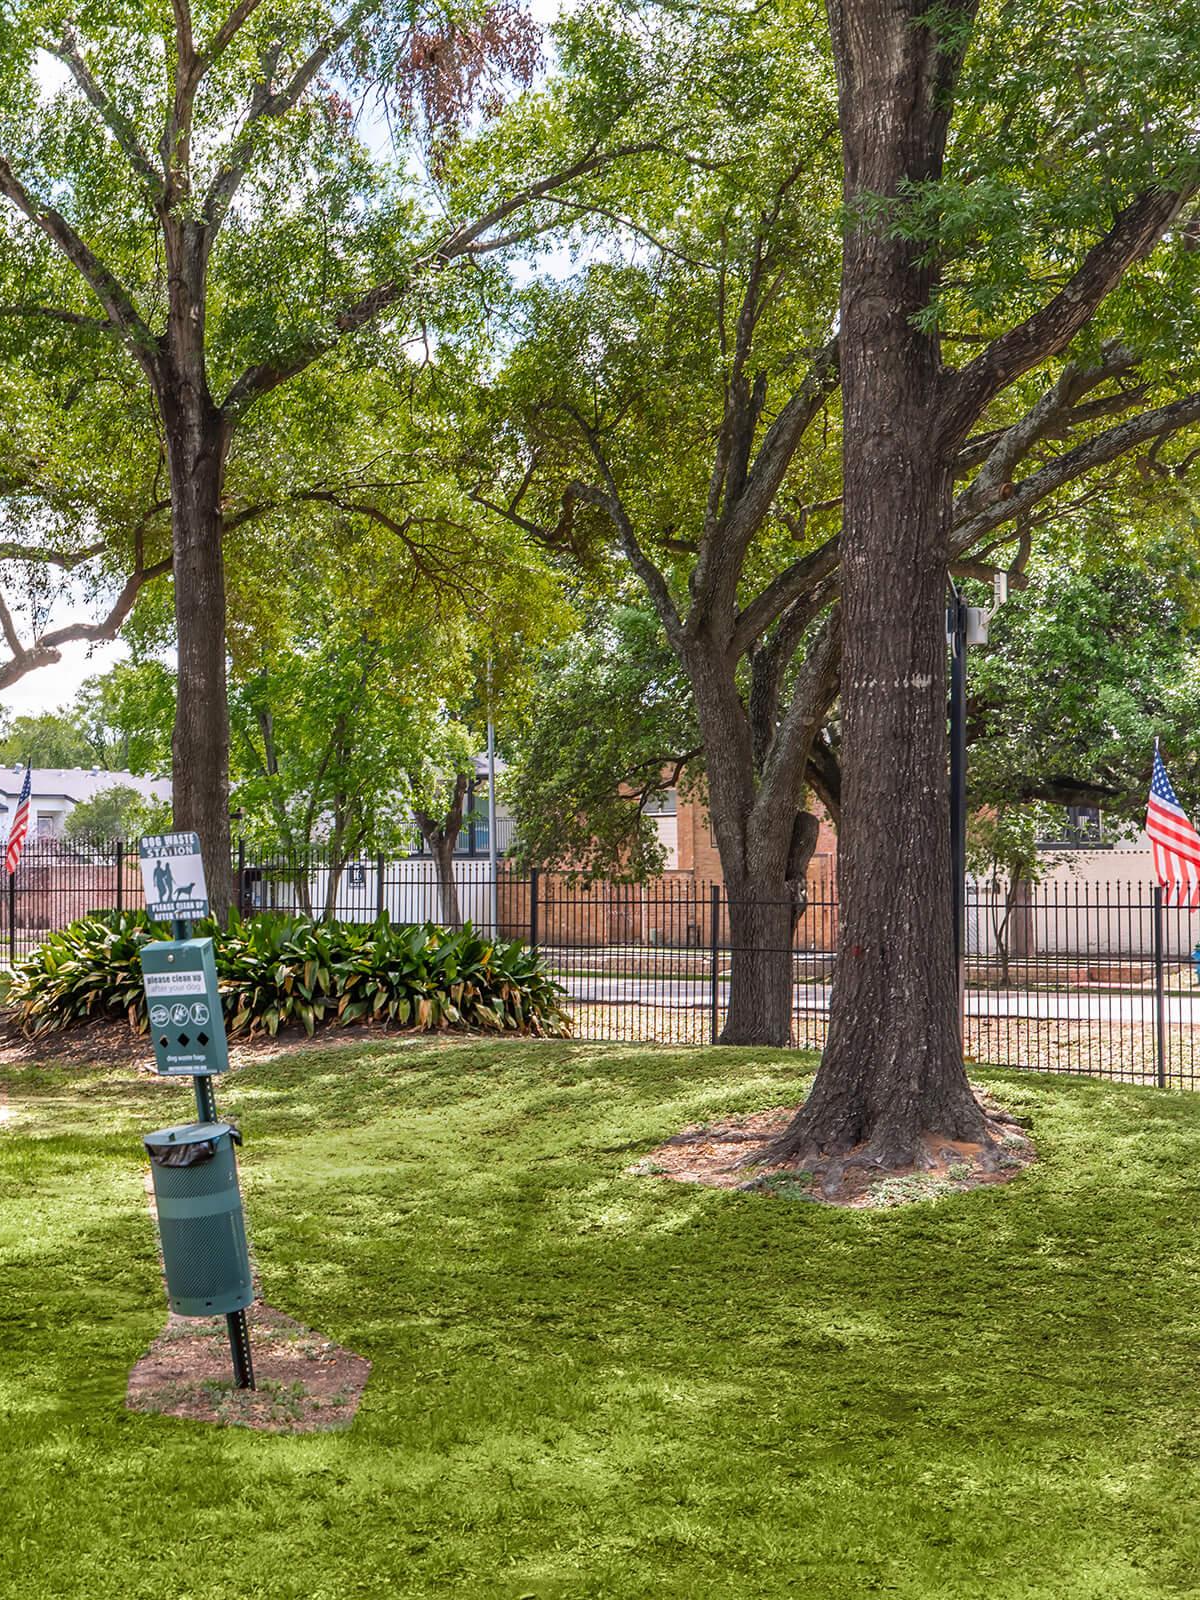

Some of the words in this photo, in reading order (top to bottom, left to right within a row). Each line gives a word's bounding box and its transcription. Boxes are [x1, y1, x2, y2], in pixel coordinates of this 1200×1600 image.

[142, 836, 161, 848] DOG
[164, 834, 194, 845] WASTE
[147, 846, 193, 858] STATION
[152, 902, 175, 912] PLEASE
[147, 975, 170, 985] please
[172, 975, 191, 983] clean
[151, 984, 167, 993] after
[168, 984, 184, 993] your
[186, 983, 201, 992] dog
